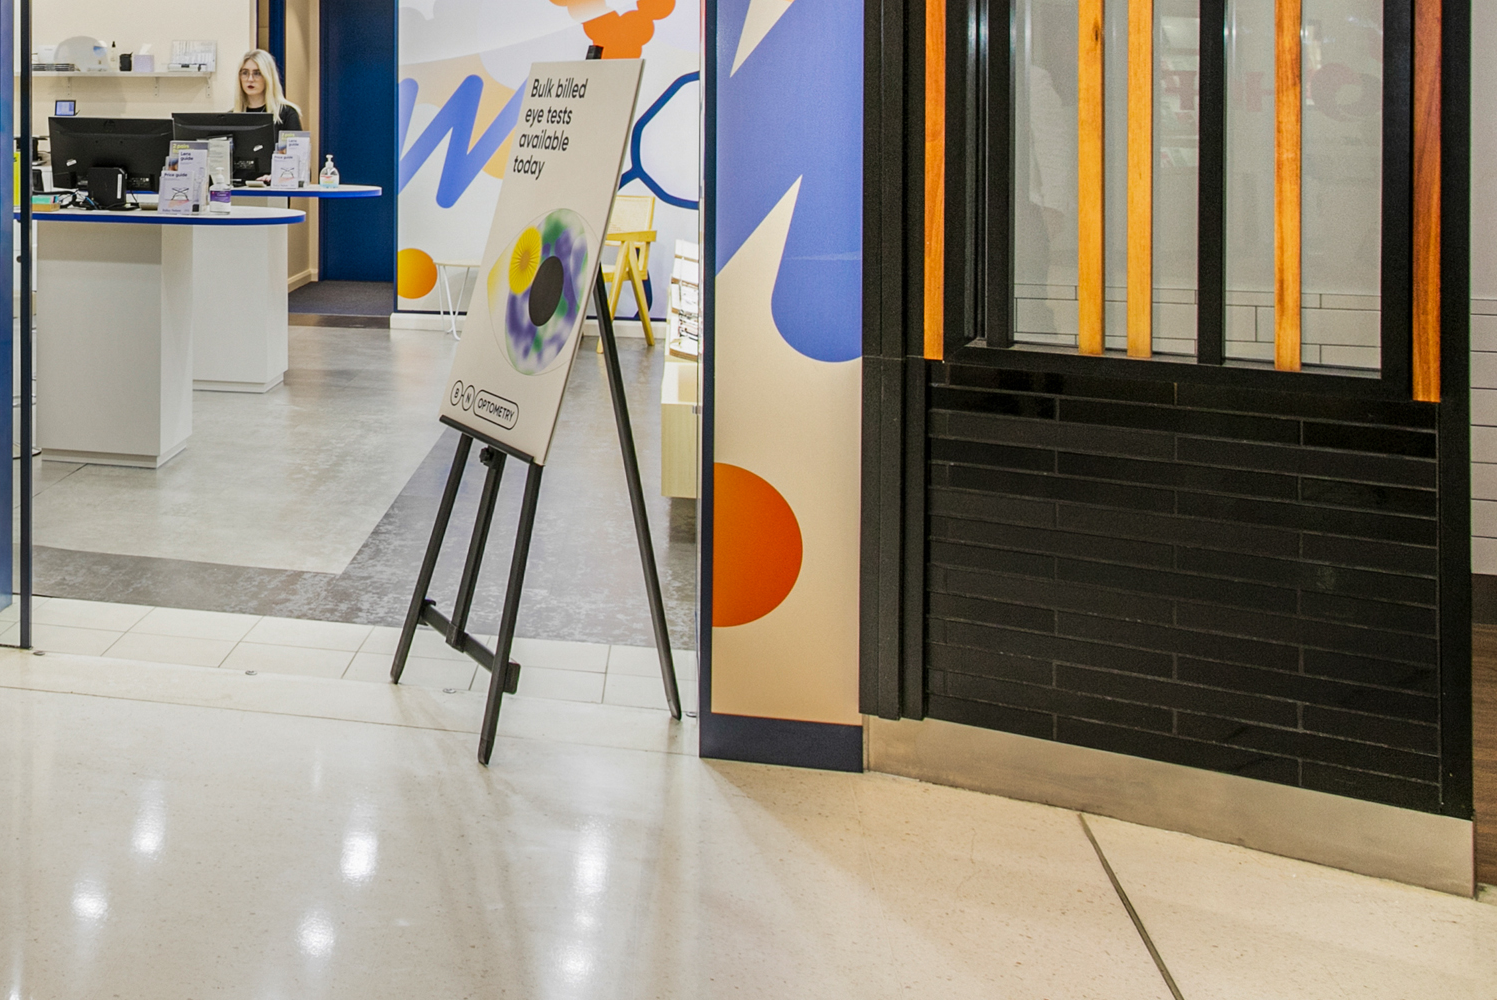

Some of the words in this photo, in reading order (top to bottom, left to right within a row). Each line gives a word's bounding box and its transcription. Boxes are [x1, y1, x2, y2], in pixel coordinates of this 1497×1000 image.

[531, 77, 555, 98] Bulk
[555, 77, 589, 99] billed
[525, 108, 545, 128] eye
[546, 106, 573, 125] tests
[519, 129, 570, 152] available
[513, 154, 545, 181] today
[477, 397, 515, 422] OPTOMETRY
